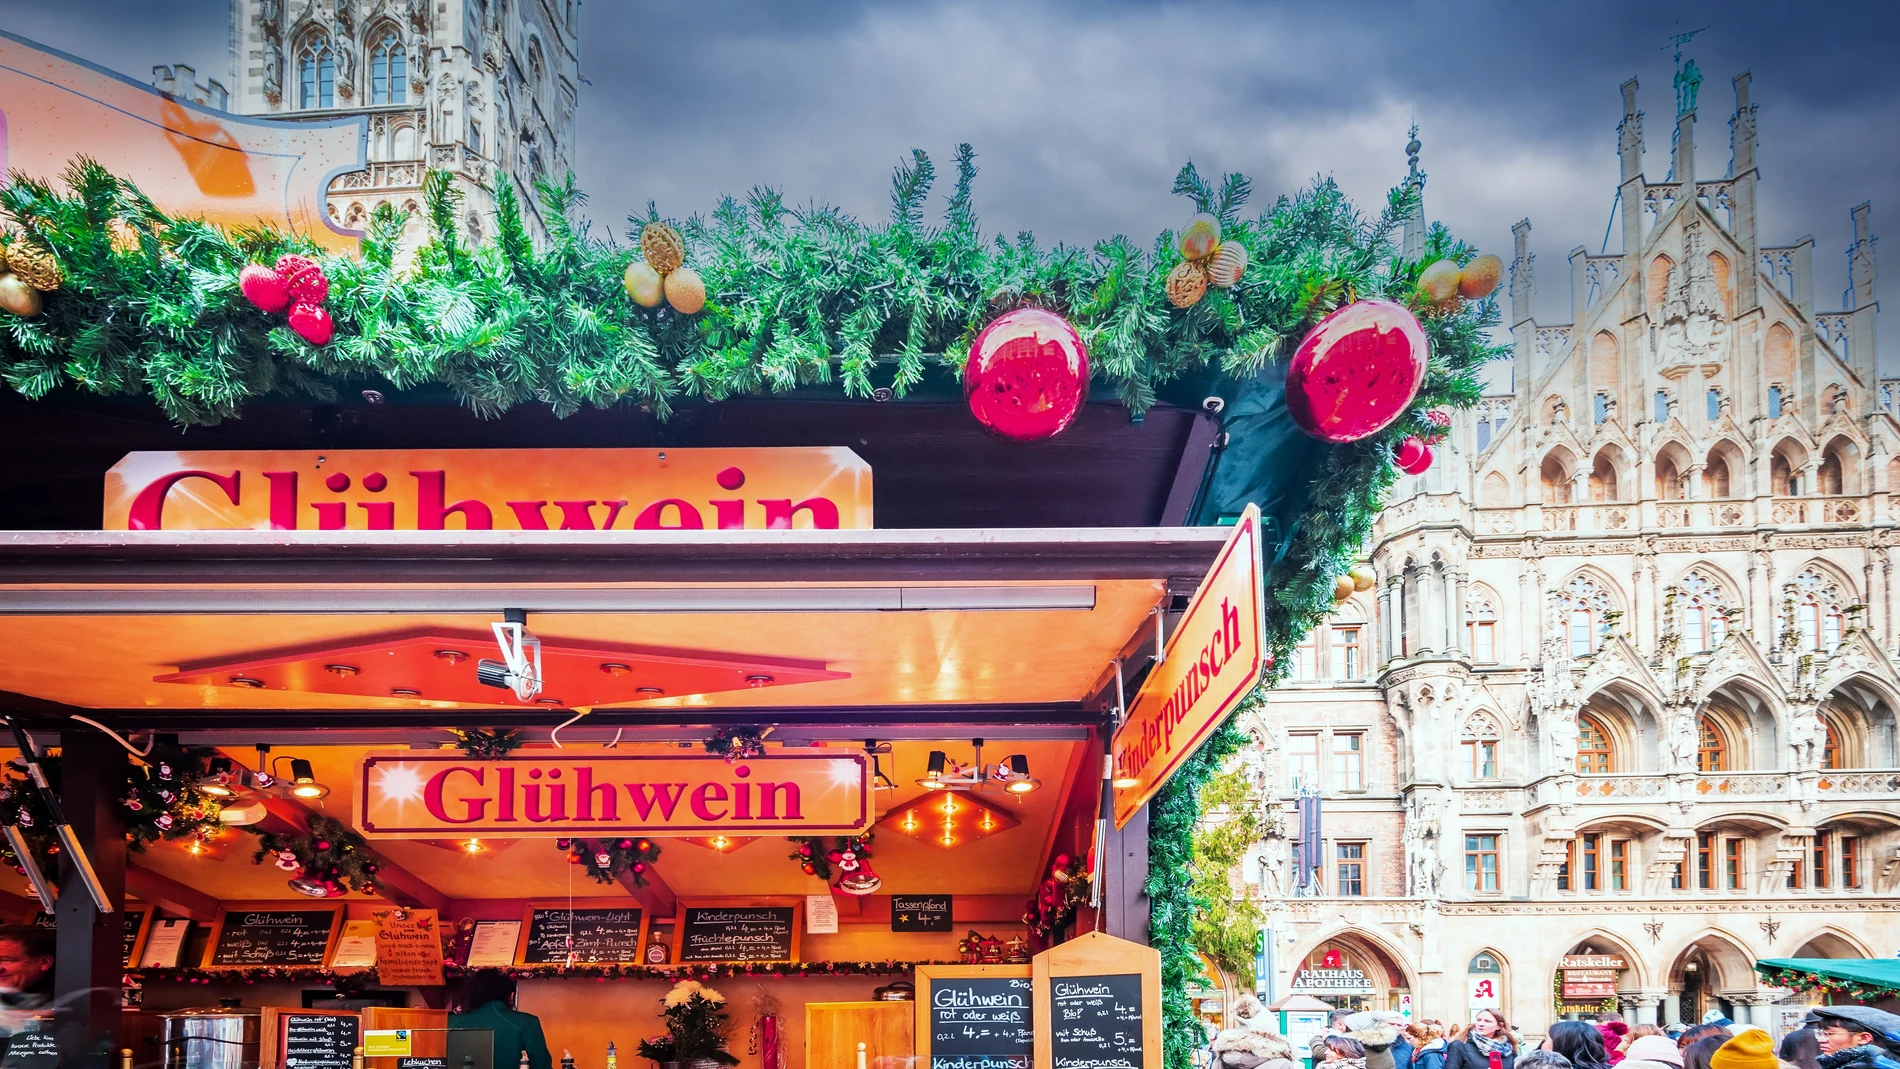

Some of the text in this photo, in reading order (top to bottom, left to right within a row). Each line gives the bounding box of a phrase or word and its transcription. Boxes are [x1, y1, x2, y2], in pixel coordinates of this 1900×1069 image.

[423, 765, 806, 825] Glühwein
[893, 897, 947, 912] Tassenpfand
[244, 914, 303, 926] Glühwein
[696, 911, 777, 923] Kinderpunsch
[690, 933, 775, 945] Früchtepunsch
[1256, 933, 1264, 953] S
[1559, 956, 1624, 967] Ratskeller
[1300, 969, 1364, 979] RATHAUS
[1293, 977, 1372, 988] APOTHEKE
[1055, 983, 1110, 996] Glühwein
[934, 987, 1023, 1008] Glühwein
[1086, 999, 1103, 1007] weiß
[940, 1008, 1021, 1023] rot oder weiß
[1072, 1027, 1097, 1037] Schuß
[403, 1057, 442, 1067] Lebkuchen
[1055, 1056, 1131, 1068] Kinderpunsch
